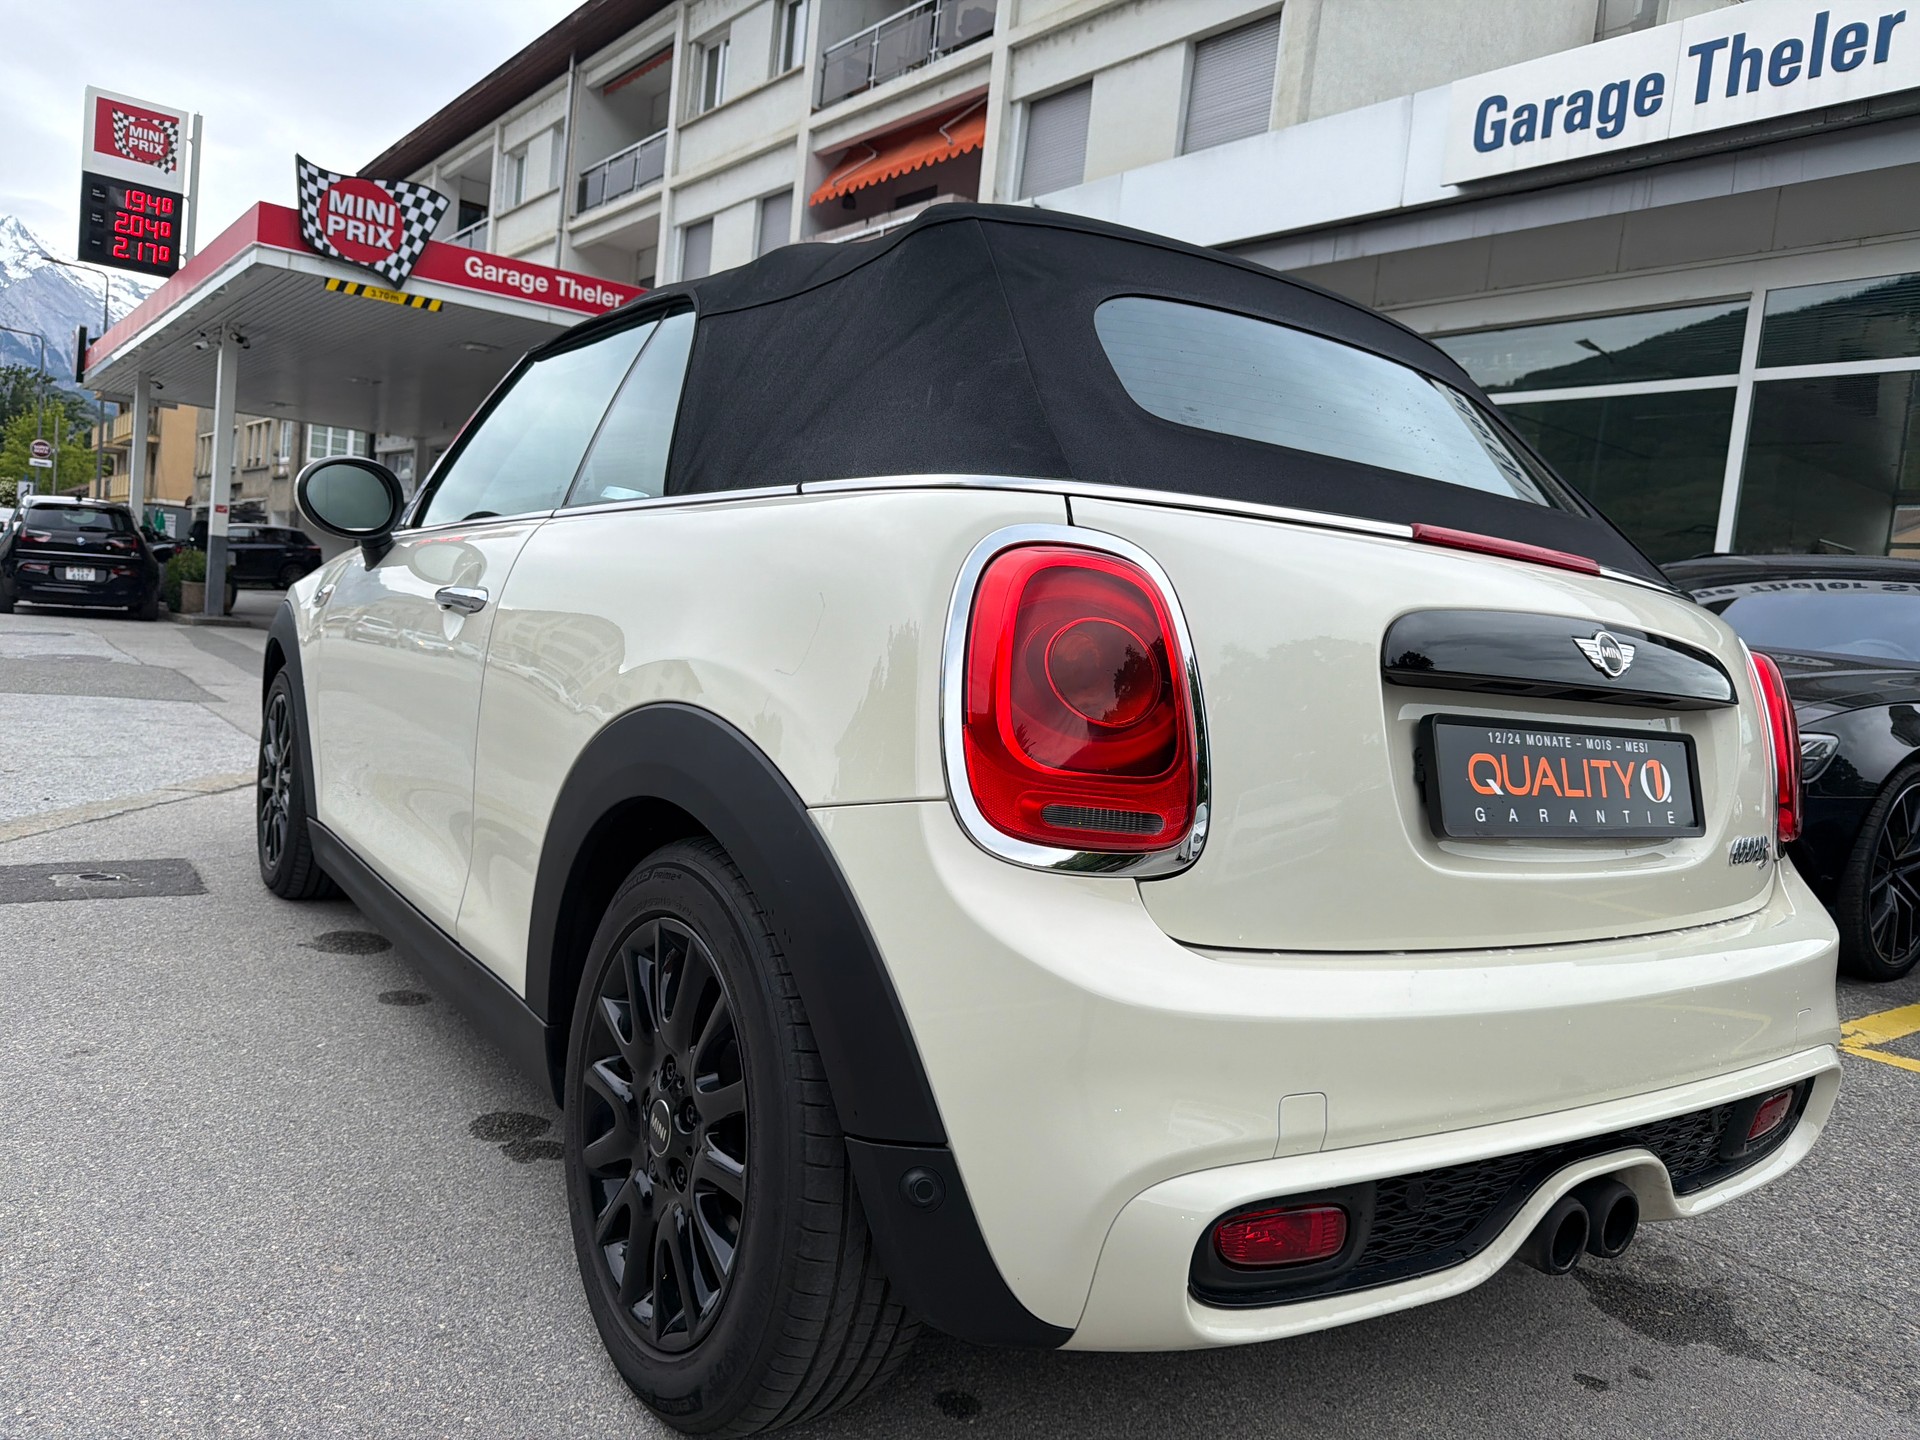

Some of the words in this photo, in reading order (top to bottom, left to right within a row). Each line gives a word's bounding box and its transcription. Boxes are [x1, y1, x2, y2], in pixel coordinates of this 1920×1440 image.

[1473, 71, 1665, 153] Garage
[1687, 9, 1907, 106] Theler
[128, 137, 164, 156] PRIX
[129, 125, 164, 144] MINI
[328, 189, 396, 227] MINI
[327, 214, 395, 251] PRIX
[464, 256, 549, 294] Garage
[554, 275, 624, 308] Theler
[1601, 646, 1622, 660] MINI
[1487, 732, 1521, 746] 12/24
[1526, 734, 1572, 748] MONATE
[1586, 738, 1612, 751] MOIS
[1625, 741, 1649, 753] MESI
[1468, 753, 1635, 799] QUALITY
[1474, 807, 1675, 824] GARANTIE
[651, 1112, 667, 1142] MINI
